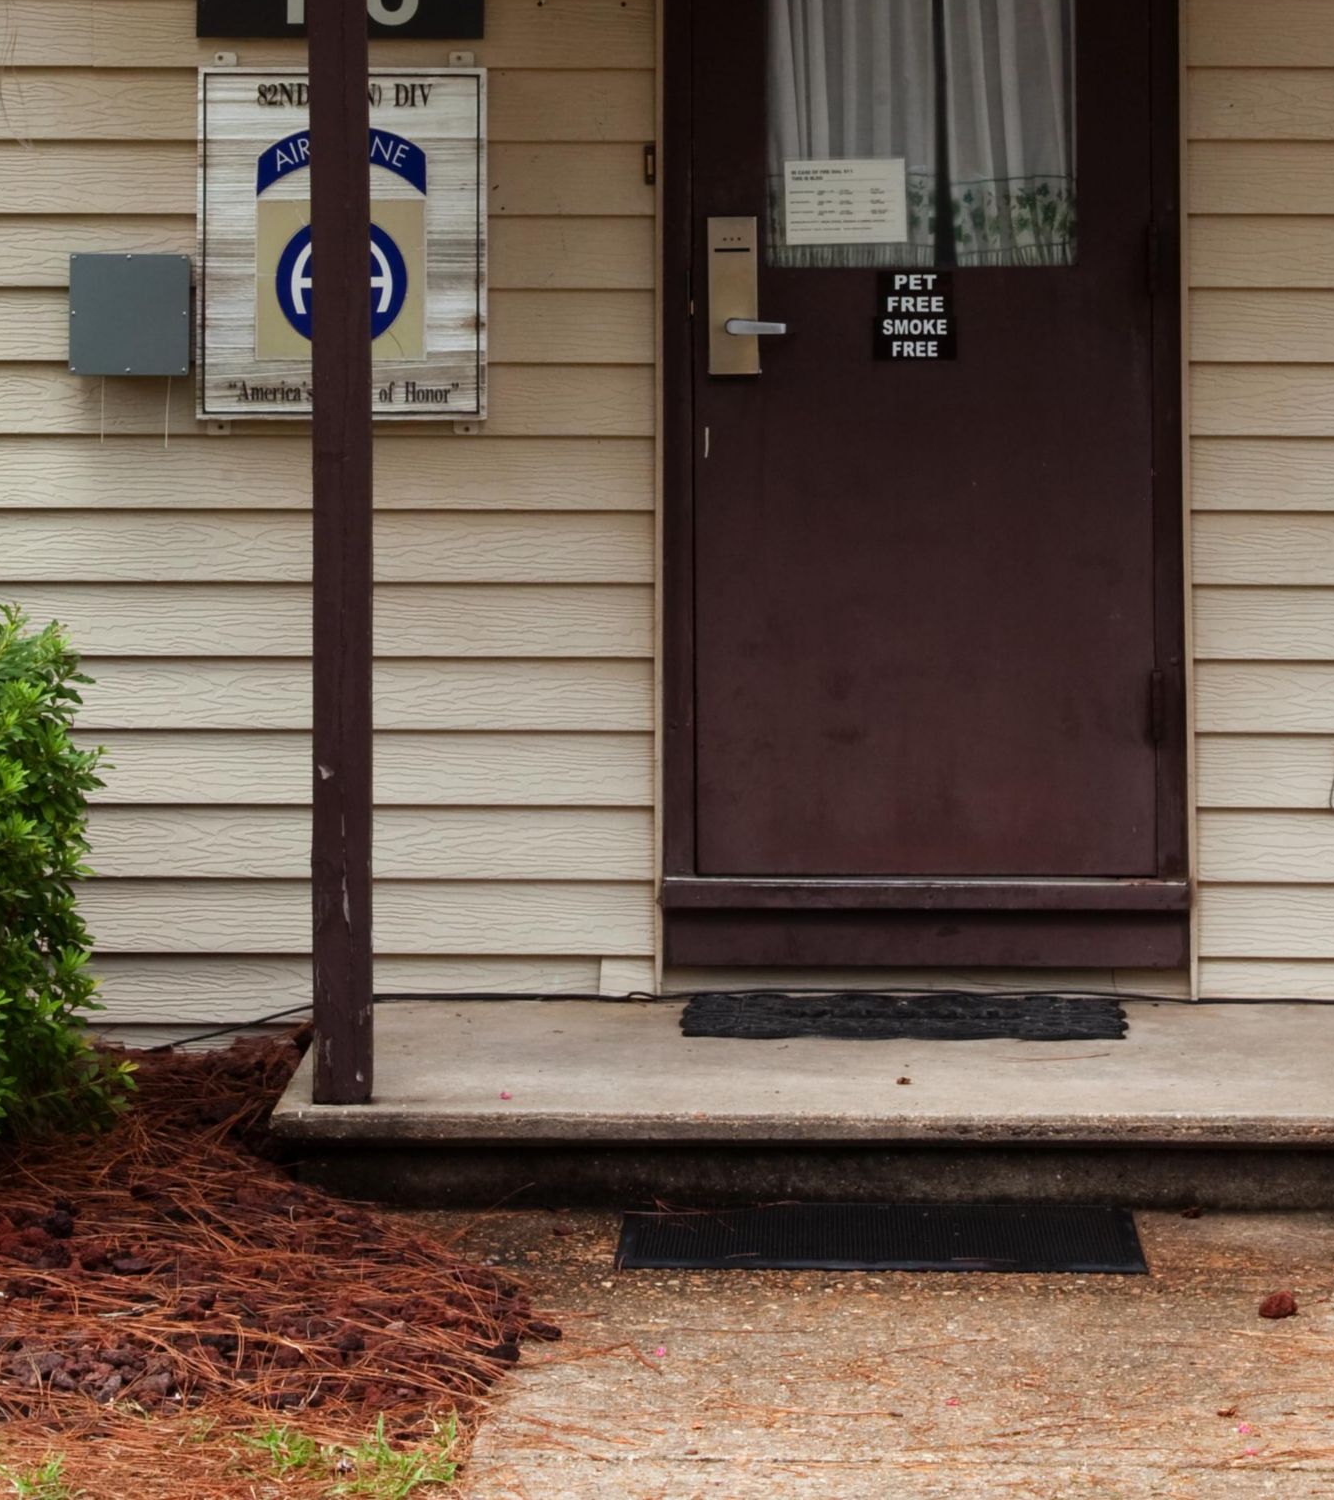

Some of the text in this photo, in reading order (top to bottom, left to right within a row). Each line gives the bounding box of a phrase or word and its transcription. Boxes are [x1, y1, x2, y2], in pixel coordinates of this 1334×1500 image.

[393, 83, 433, 107] DIV
[276, 136, 410, 172] AIRNE
[894, 274, 937, 290] PET
[887, 297, 944, 312] FREE
[882, 319, 947, 335] SMOKE
[892, 341, 938, 357] FREE
[379, 382, 395, 403] of
